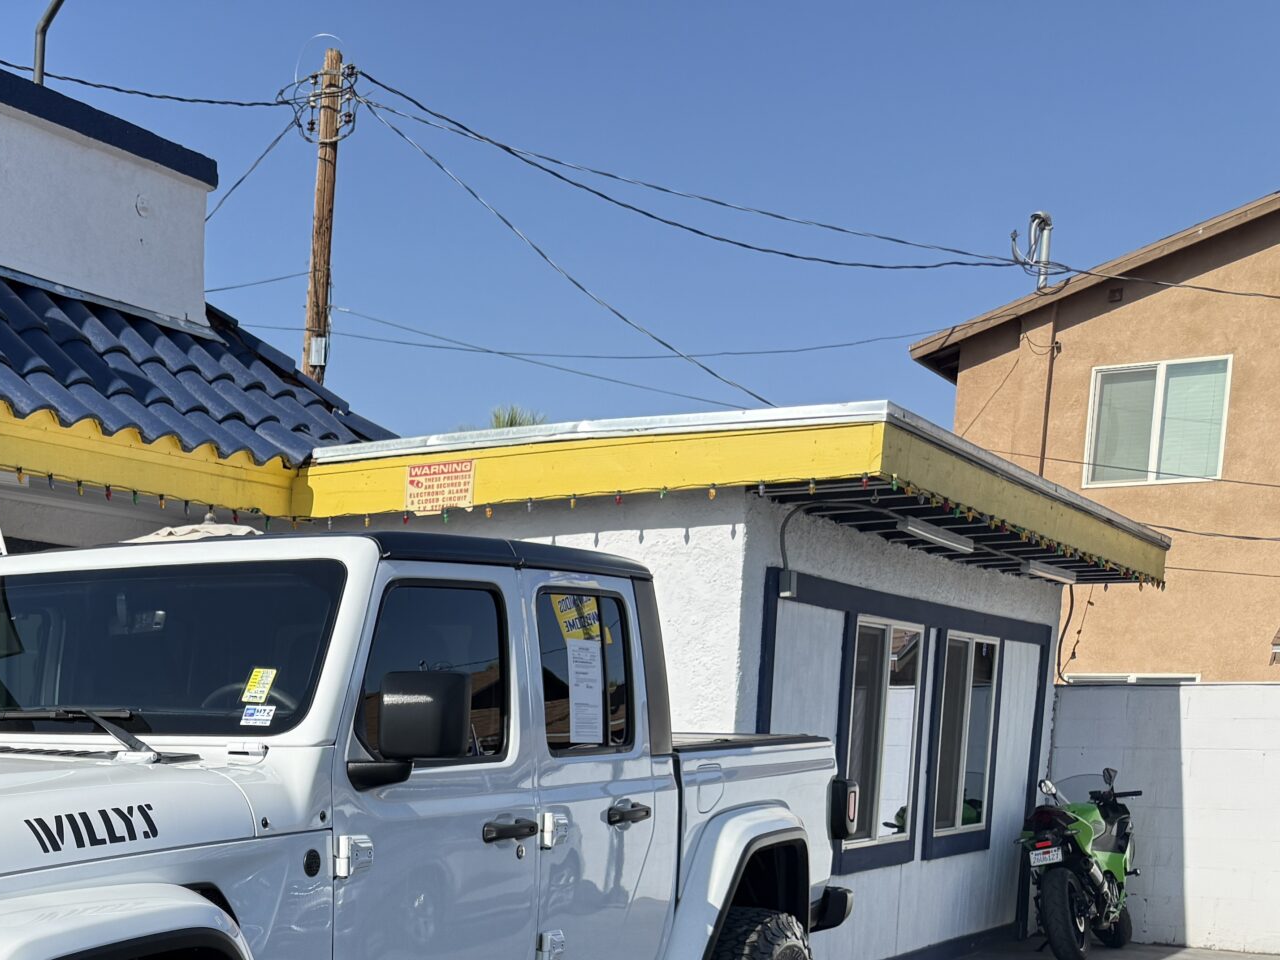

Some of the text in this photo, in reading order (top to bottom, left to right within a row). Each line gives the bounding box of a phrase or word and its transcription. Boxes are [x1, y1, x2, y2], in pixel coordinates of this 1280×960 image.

[410, 462, 472, 476] WARNING
[436, 481, 462, 489] SECURED
[409, 490, 445, 499] ELECTRONIC
[24, 803, 159, 854] WILLYS
